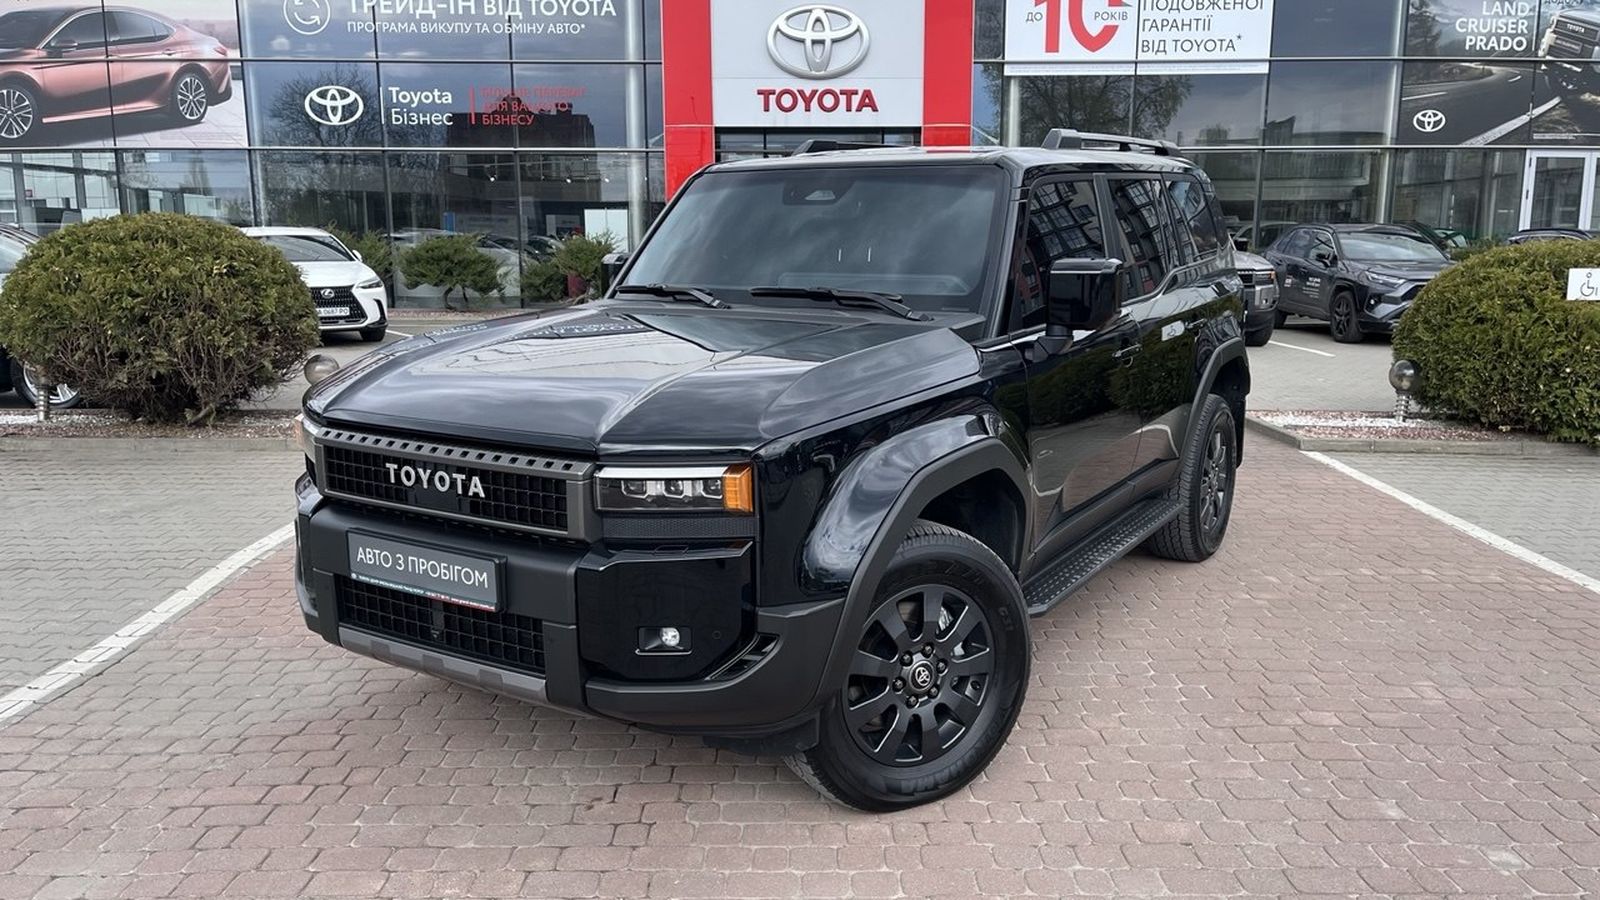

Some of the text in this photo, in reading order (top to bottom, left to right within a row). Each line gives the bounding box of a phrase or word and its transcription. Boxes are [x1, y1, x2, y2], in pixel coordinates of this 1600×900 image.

[483, 0, 523, 19] ВІД
[531, 0, 616, 16] TOYOTA
[1025, 12, 1043, 22] ДО
[1094, 11, 1128, 21] РОКІВ
[1482, 1, 1530, 17] LAND
[347, 21, 418, 33] ПРОГРАМА
[420, 21, 472, 34] ВИКУПУ
[475, 22, 490, 33] ТА
[493, 22, 545, 34] ОБМІНУ
[1142, 15, 1213, 32] ГАРАНТІЇ
[1455, 18, 1528, 34] CRUISER
[1141, 39, 1167, 55] ВІД
[1465, 36, 1527, 51] PRADO
[388, 87, 452, 106] Toyota
[757, 88, 879, 113] TOYOTA
[391, 108, 453, 126] Бізнес
[482, 114, 534, 125] БІЗНЕСУ
[385, 463, 486, 498] TOYOTA
[357, 546, 393, 568] АВТО
[396, 553, 405, 571] З
[408, 556, 488, 589] ПРОБІГОМ
